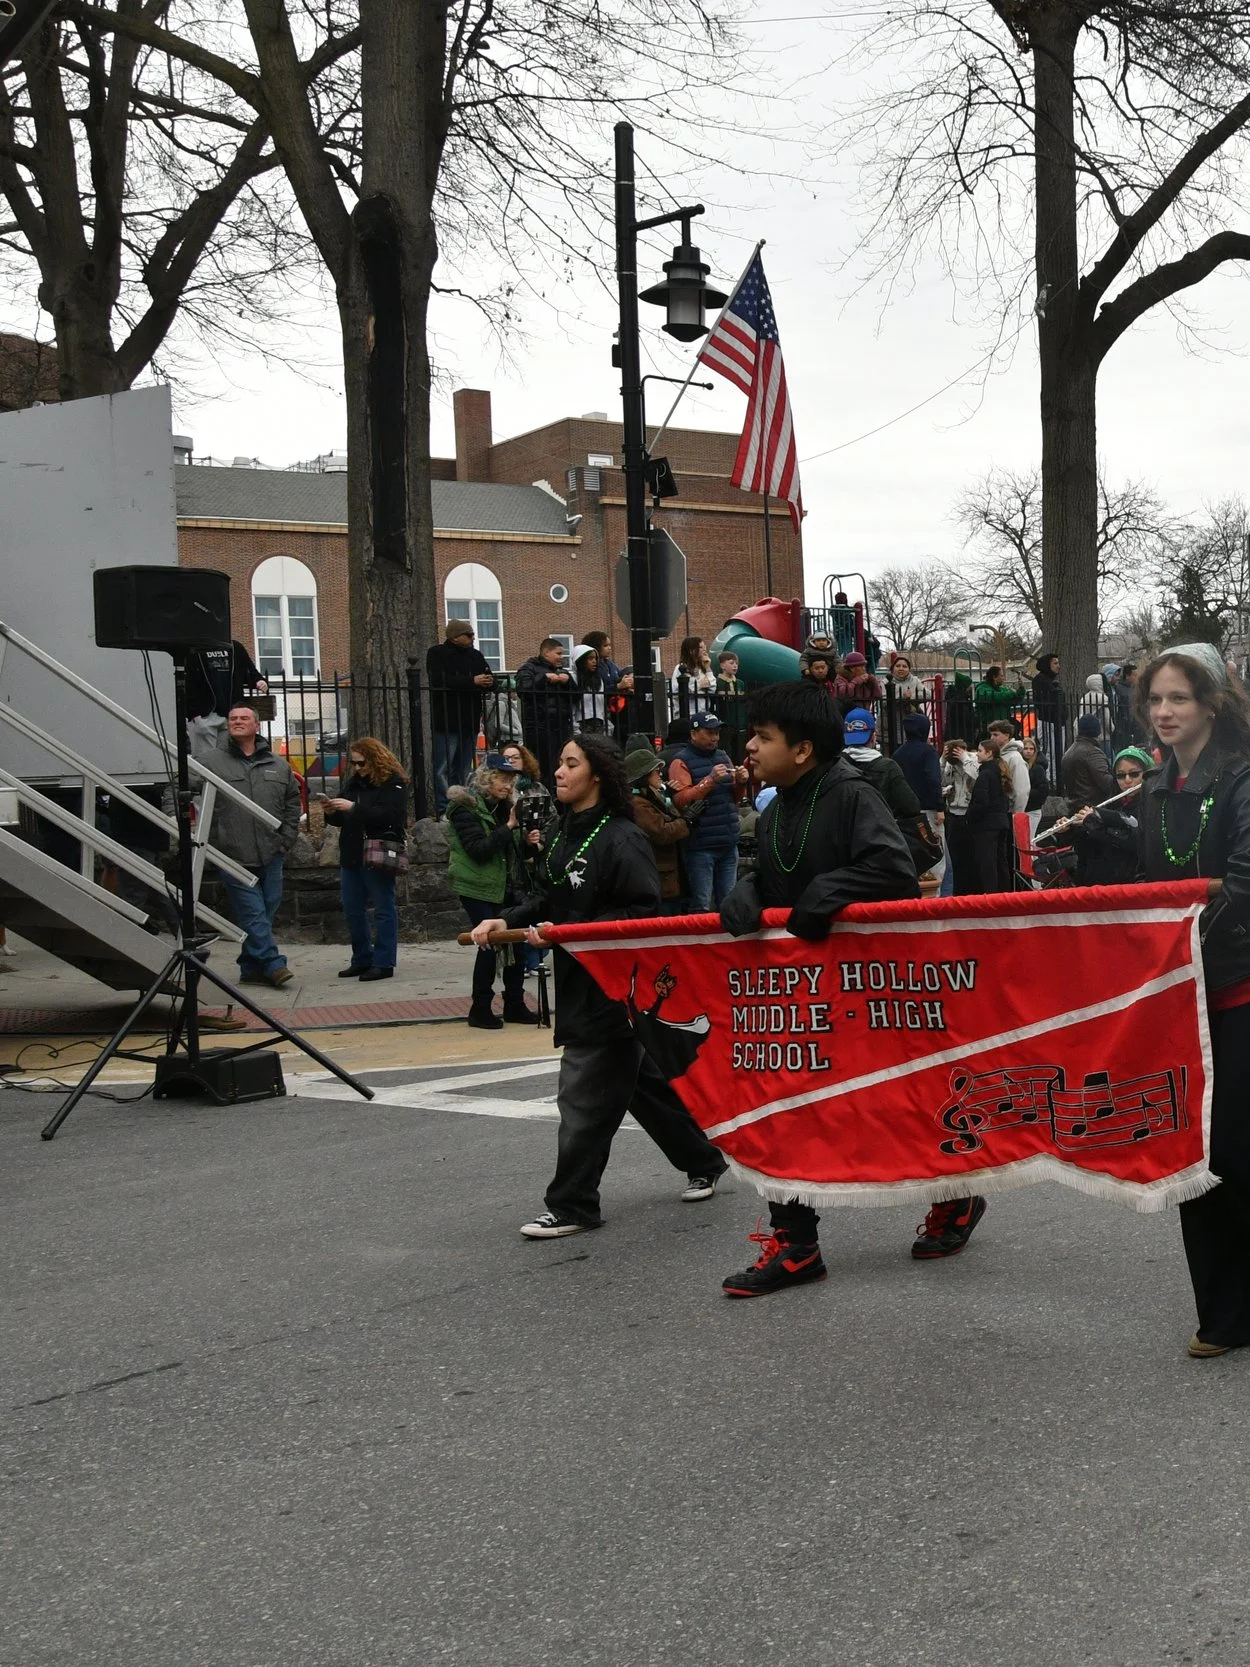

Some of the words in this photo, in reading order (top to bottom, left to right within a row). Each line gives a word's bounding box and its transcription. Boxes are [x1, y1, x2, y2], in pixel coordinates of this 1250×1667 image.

[728, 966, 822, 996] SLEEPY
[841, 960, 976, 991] HOLLOW
[732, 1003, 831, 1033] MIDDLE
[868, 1000, 945, 1029] HIGH
[732, 1042, 830, 1071] SCHOOL
